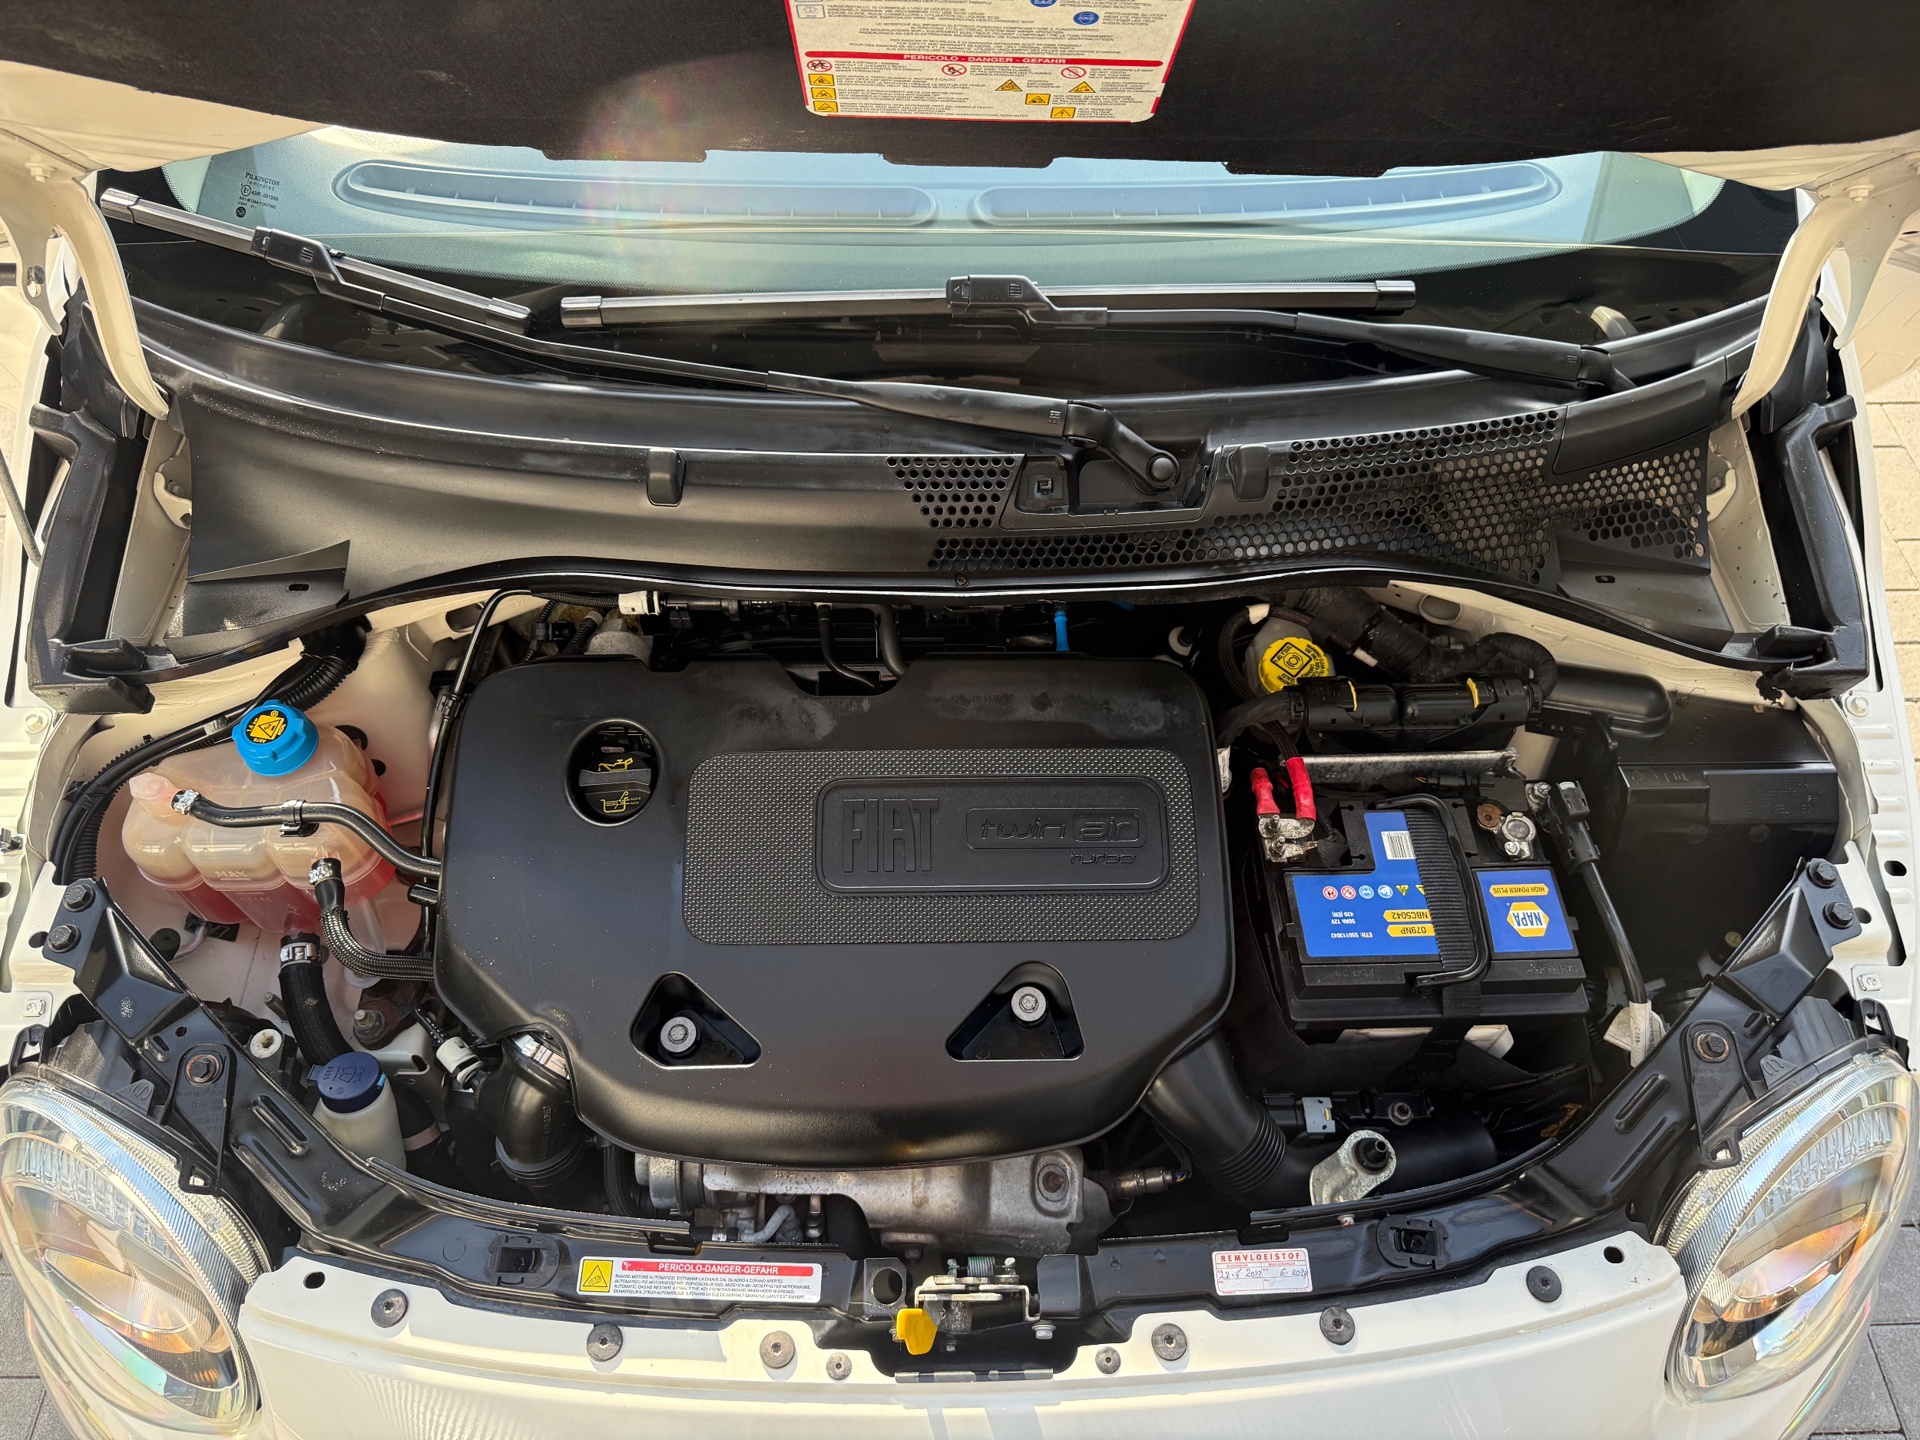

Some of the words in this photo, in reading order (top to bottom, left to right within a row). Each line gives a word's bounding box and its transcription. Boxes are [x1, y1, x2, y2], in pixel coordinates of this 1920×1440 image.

[245, 172, 280, 186] PILKINGTON
[842, 798, 940, 873] FIAT
[981, 817, 1066, 840] twin
[1079, 817, 1134, 841] air
[1070, 851, 1136, 864] turbo
[1392, 911, 1428, 920] NBC5042
[1512, 912, 1543, 926] NAPA
[1221, 1252, 1300, 1262] REMVLOEISTOF
[658, 1263, 779, 1274] PERICOLO-DANGER-GEFAHR
